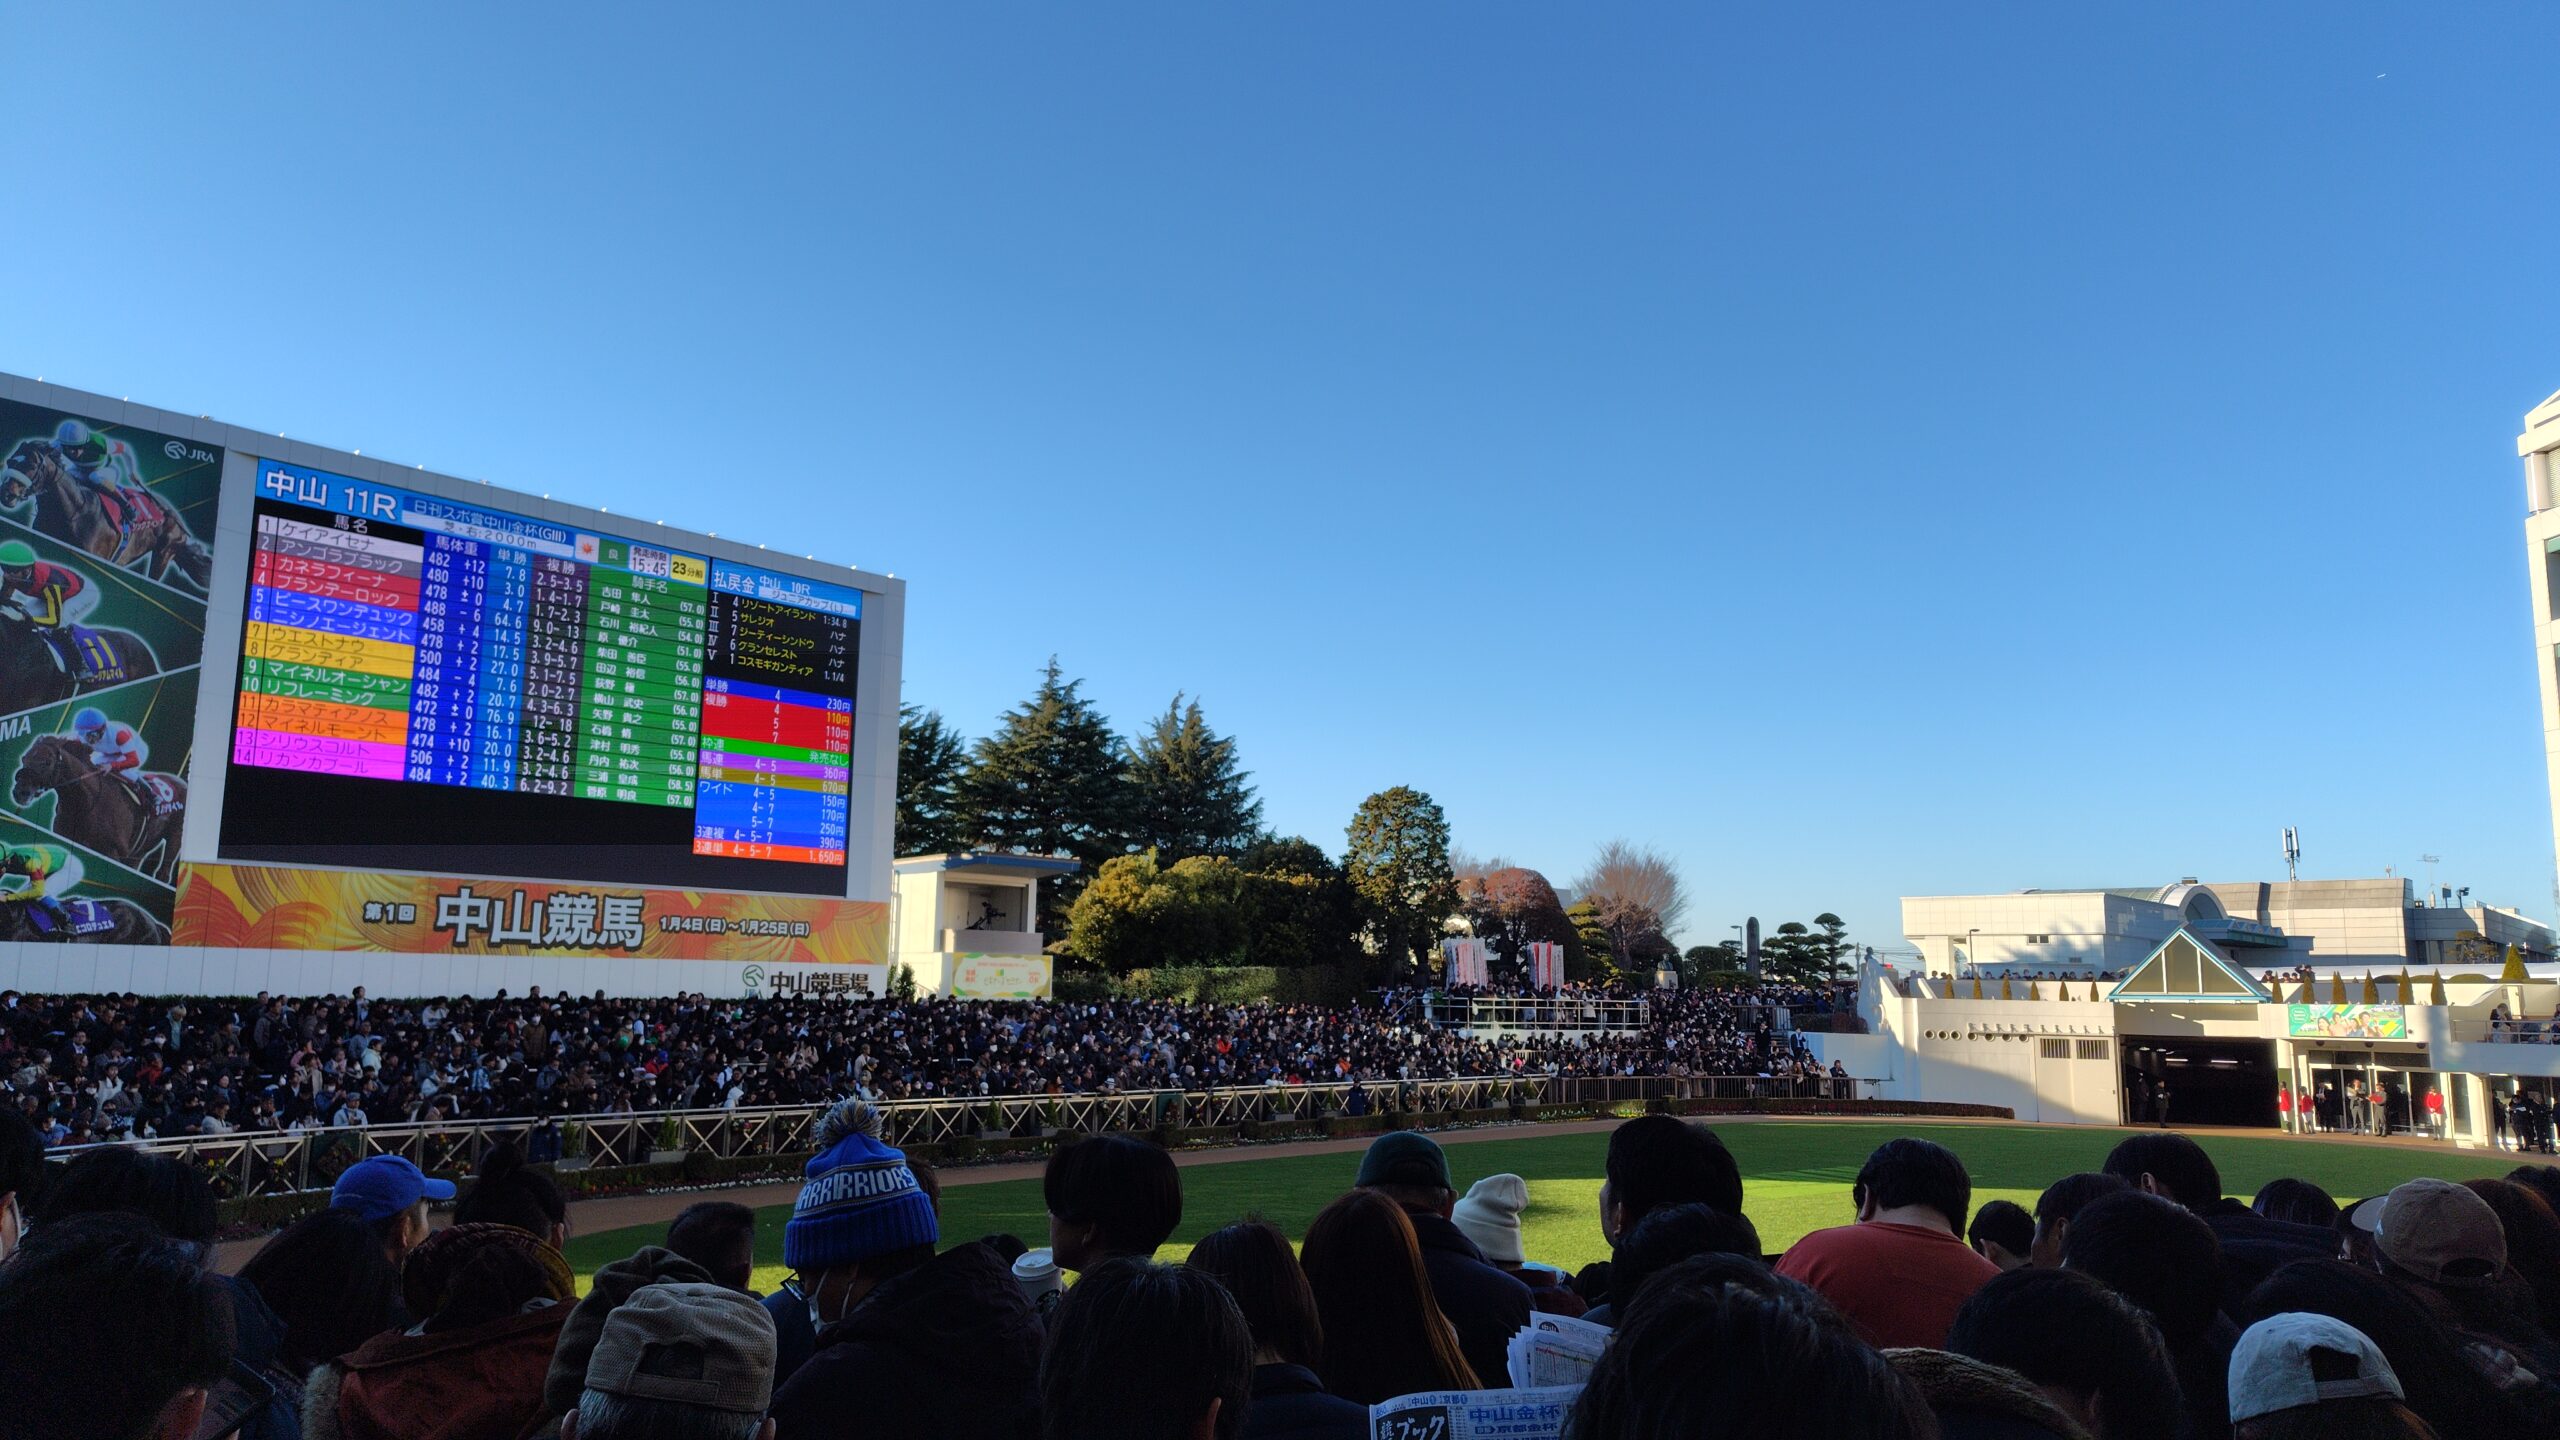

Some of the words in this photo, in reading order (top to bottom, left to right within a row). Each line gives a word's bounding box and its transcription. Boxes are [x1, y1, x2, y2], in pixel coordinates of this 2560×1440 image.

[187, 449, 215, 463] JRA
[265, 466, 328, 506] 中山
[343, 485, 397, 521] 11R
[333, 513, 369, 534] 馬名
[262, 517, 271, 532] 1
[282, 521, 374, 552] ケイアイセナ
[427, 550, 451, 567] 482
[463, 557, 485, 574] +12
[504, 565, 526, 582] 7.8
[435, 534, 478, 556] 馬体重
[497, 547, 527, 566] 単勝
[260, 534, 269, 550] 2
[280, 538, 402, 575] アンゴラブラック
[426, 566, 449, 583] 480
[461, 573, 484, 590] +10
[503, 581, 524, 598] 3.0
[546, 557, 575, 576] 複勝
[632, 556, 666, 576] 15:45
[258, 552, 268, 567] 3
[278, 555, 386, 589] カネラフィーナ
[424, 583, 448, 600] 478
[501, 597, 523, 613] 4.7
[631, 574, 668, 594] 騎手名
[713, 568, 756, 595] 払戻金
[759, 573, 781, 589] 中山
[791, 581, 810, 595] 10R
[257, 569, 266, 585] 4
[423, 599, 447, 616] 488
[494, 612, 522, 629] 64.6
[740, 597, 816, 622] リゾートアイランド
[823, 614, 847, 628] 1:34.8
[255, 587, 264, 603] 5
[422, 616, 445, 633] 458
[492, 628, 521, 645] 14.5
[740, 611, 774, 628] サレジオ
[830, 630, 846, 642] ハナ
[253, 605, 263, 620] 6
[273, 608, 411, 644] ニシノエージェント
[420, 632, 444, 649] 478
[491, 644, 519, 661] 17.5
[251, 622, 261, 638] 7
[271, 626, 365, 654] ウエストナウ
[419, 649, 442, 666] 500
[490, 660, 518, 677] 27.0
[738, 640, 797, 660] グランセレスト
[828, 657, 845, 669] ハナ
[829, 643, 846, 655] ハナ
[250, 640, 259, 656] 8
[270, 643, 364, 671] グランディア
[417, 665, 441, 682] 484
[495, 677, 517, 693] 7.6
[737, 654, 813, 677] コスモギガンティア
[248, 658, 257, 674] 9
[268, 661, 406, 694] マイネルオーシャン
[416, 682, 440, 699] 482
[487, 692, 516, 709] 20.7
[705, 678, 728, 693] 単勝
[826, 697, 850, 712] 230円
[242, 675, 259, 692] 10
[266, 679, 375, 707] リフレーミング
[414, 699, 438, 715] 472
[486, 708, 514, 725] 76.9
[704, 692, 727, 708] 複勝
[826, 711, 850, 726] 110円
[240, 693, 258, 710] 11
[264, 697, 389, 726] カラマティアノス
[413, 716, 437, 732] 478
[484, 725, 513, 741] 16.1
[239, 711, 256, 728] 12
[263, 714, 387, 743] マイネルモーント
[412, 732, 435, 749] 474
[448, 737, 471, 753] +10
[483, 741, 512, 757] 20.0
[825, 725, 849, 740] 110円
[825, 739, 848, 753] 110円
[237, 730, 254, 746] 13
[261, 732, 371, 759] シリウスコルト
[410, 749, 434, 765] 506
[482, 757, 510, 774] 11.9
[701, 751, 723, 766] 馬連
[822, 766, 847, 781] 360円
[702, 736, 724, 751] 枠連
[809, 750, 847, 767] 発売なし
[235, 748, 252, 764] 14
[259, 750, 369, 776] リカンカブール
[409, 766, 432, 782] 484
[480, 774, 509, 790] 40.3
[700, 766, 722, 780] 馬単
[822, 780, 846, 795] 670円
[699, 781, 733, 796] ワイド
[822, 794, 845, 808] 150円
[819, 822, 844, 836] 250円
[821, 808, 845, 822] 170円
[695, 840, 723, 854] 3連単
[696, 825, 725, 840] 3連複
[819, 836, 843, 850] 390円
[364, 901, 416, 923] 第1回
[435, 886, 645, 950] 中山競馬
[770, 971, 869, 995] 中山競馬場
[1469, 1404, 1560, 1423] 中山金杯
